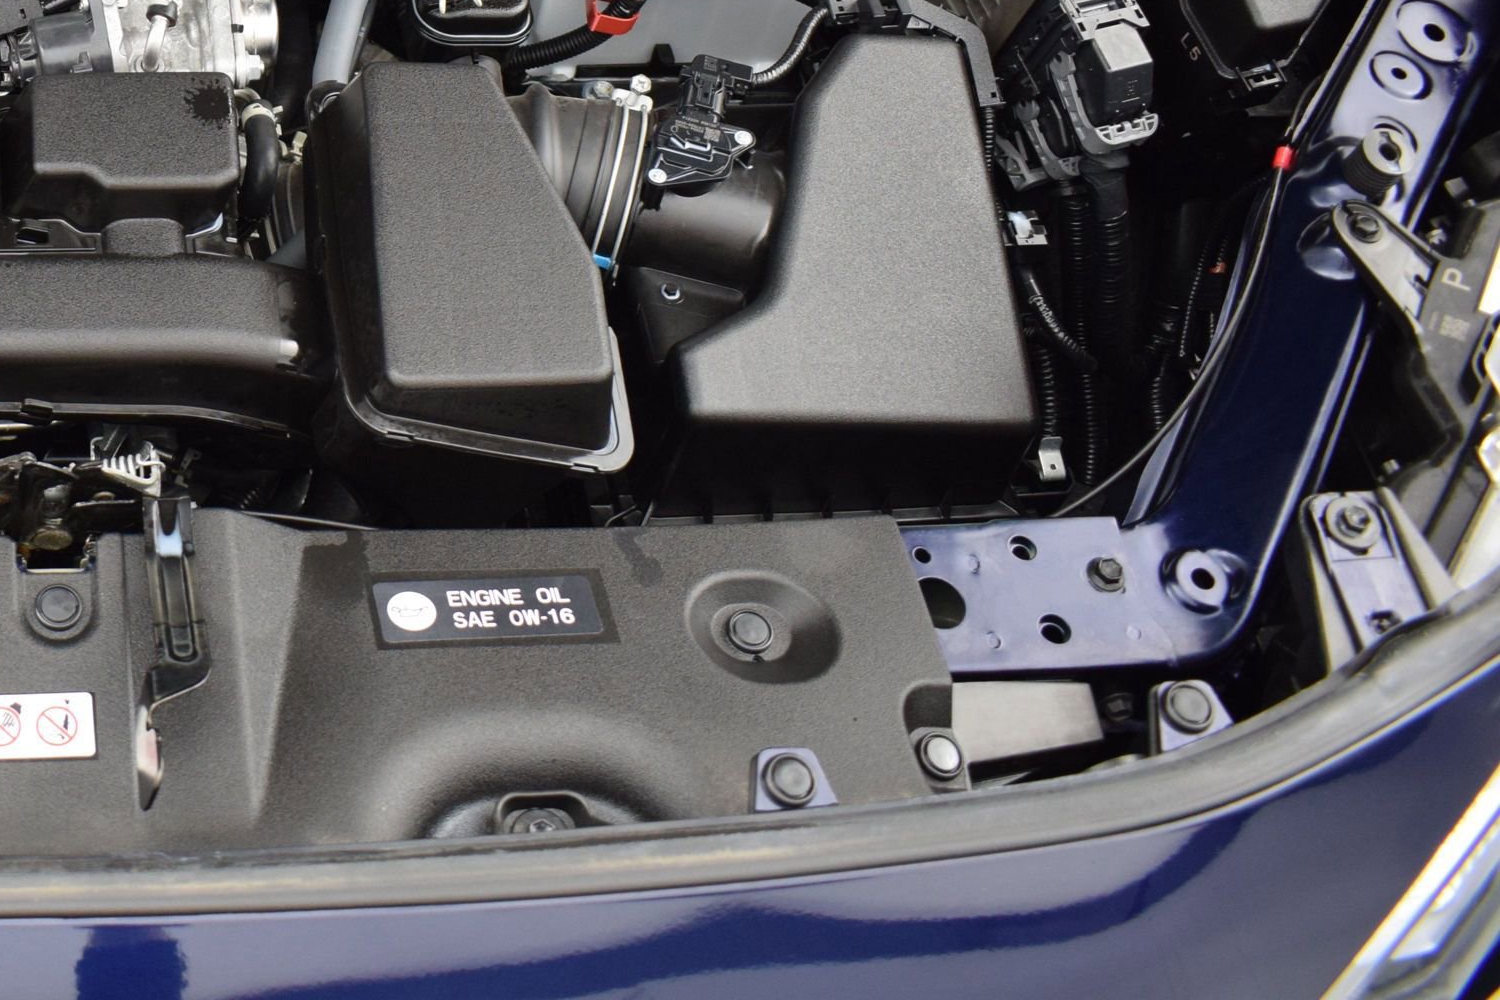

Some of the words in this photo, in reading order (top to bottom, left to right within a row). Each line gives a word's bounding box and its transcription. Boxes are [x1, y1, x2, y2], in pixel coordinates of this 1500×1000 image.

[1442, 267, 1471, 291] P
[446, 588, 524, 607] ENGINE
[535, 587, 571, 604] OIL
[453, 610, 497, 628] SAE
